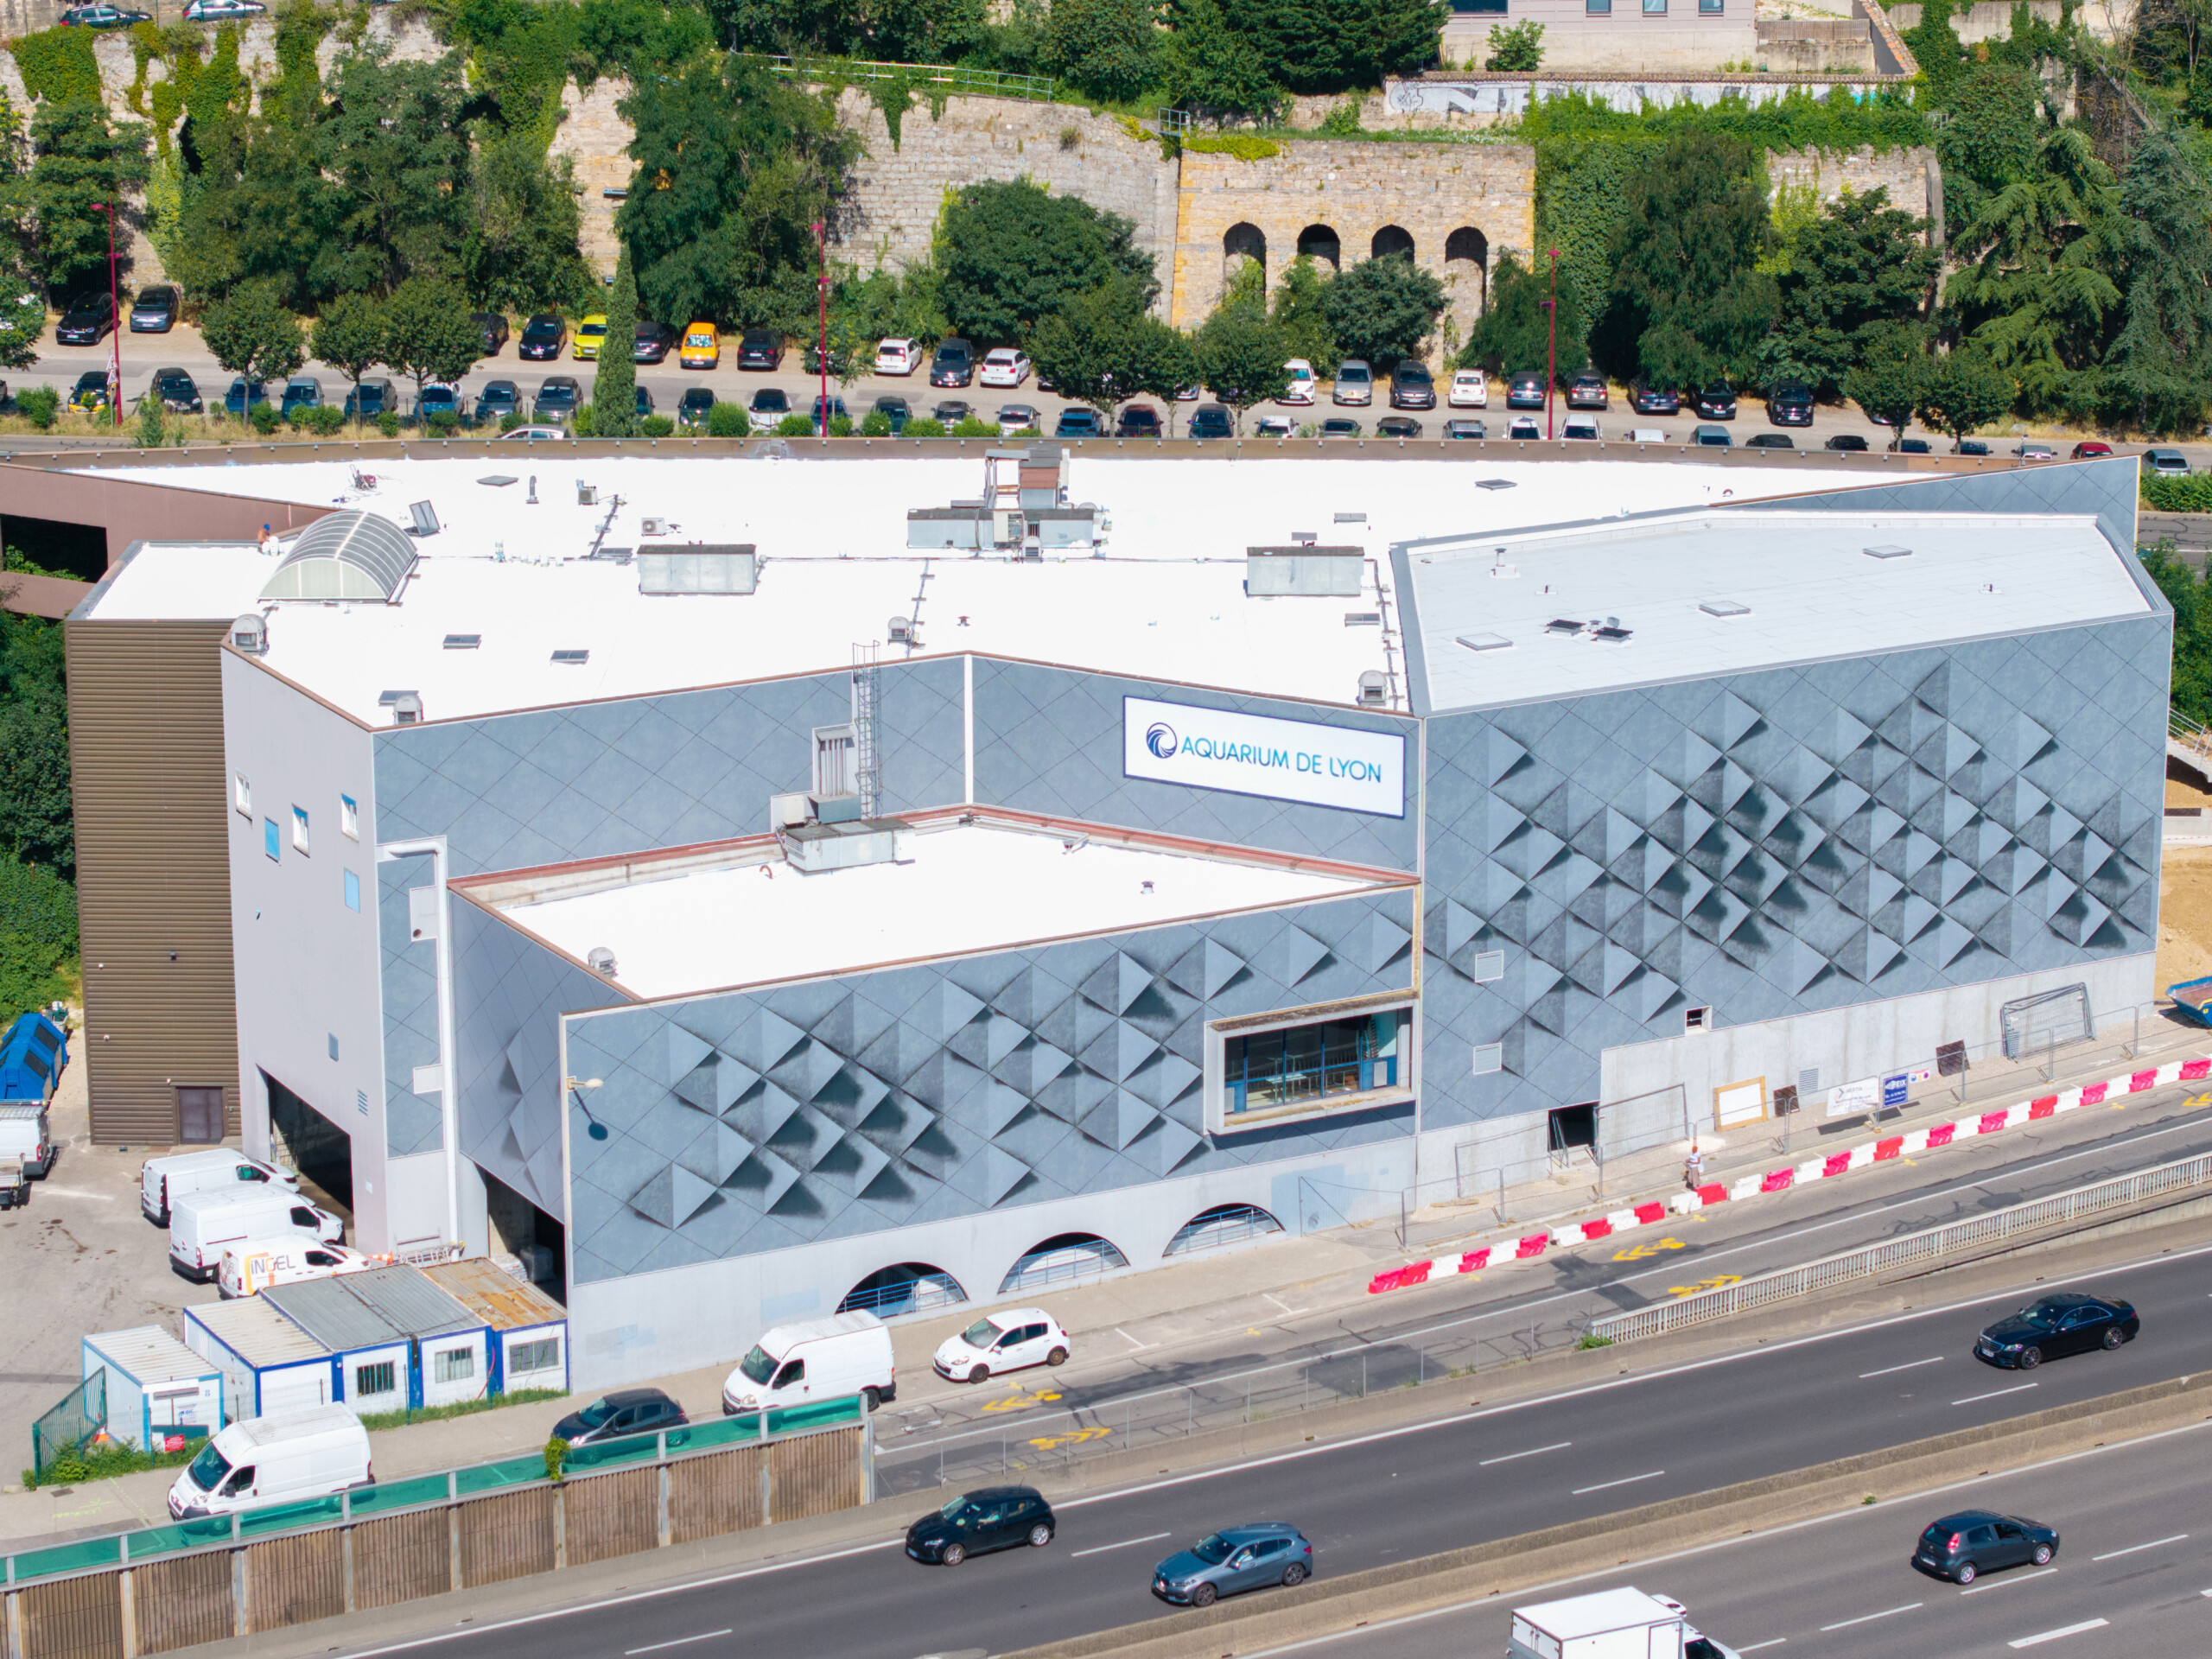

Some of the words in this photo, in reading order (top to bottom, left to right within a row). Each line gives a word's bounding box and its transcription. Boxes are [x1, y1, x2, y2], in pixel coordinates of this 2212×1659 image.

[1181, 736, 1289, 769] AQUARIUM
[1296, 752, 1322, 774] DE
[1329, 757, 1382, 783] LYON
